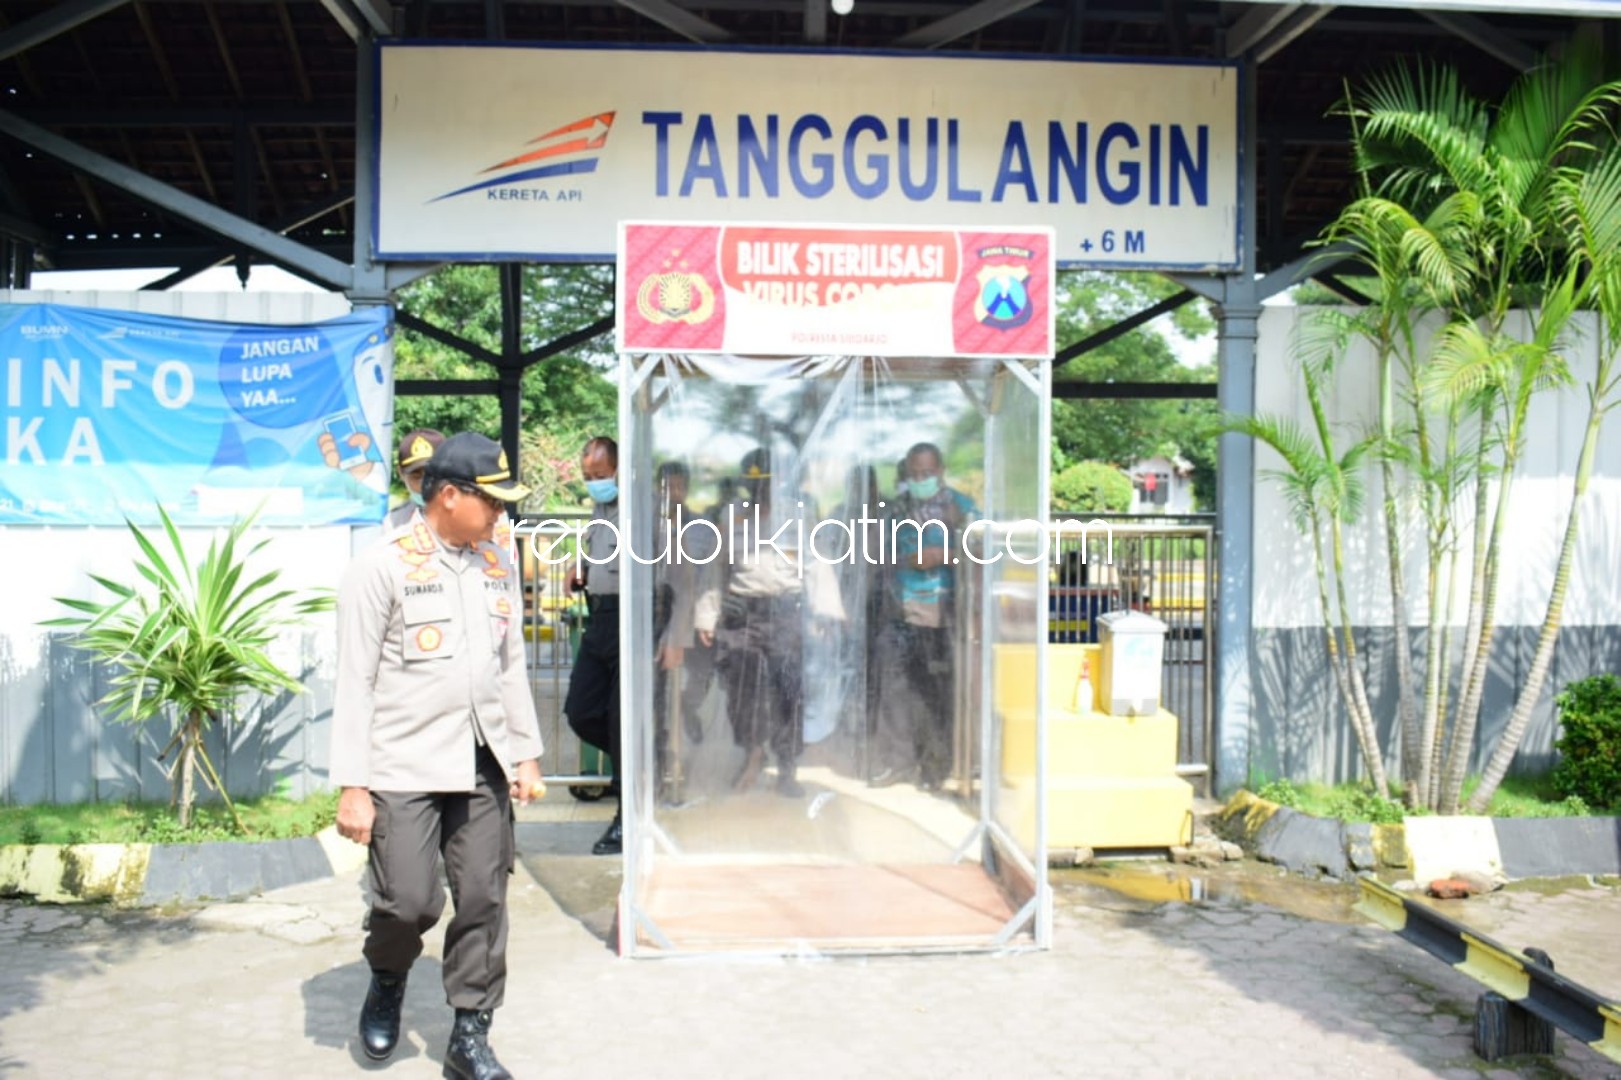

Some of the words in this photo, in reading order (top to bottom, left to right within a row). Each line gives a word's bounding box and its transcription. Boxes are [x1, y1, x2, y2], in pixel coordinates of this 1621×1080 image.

[642, 111, 1209, 207] TANGGULANGIN
[487, 189, 549, 201] KERETA
[557, 189, 582, 202] API
[737, 242, 799, 276] BILIK
[805, 243, 945, 280] STERILISASI
[20, 325, 69, 335] BUMN
[241, 336, 319, 360] JANGAN
[8, 357, 195, 409] INFO
[241, 368, 293, 384] LUPA
[6, 416, 106, 466] KA
